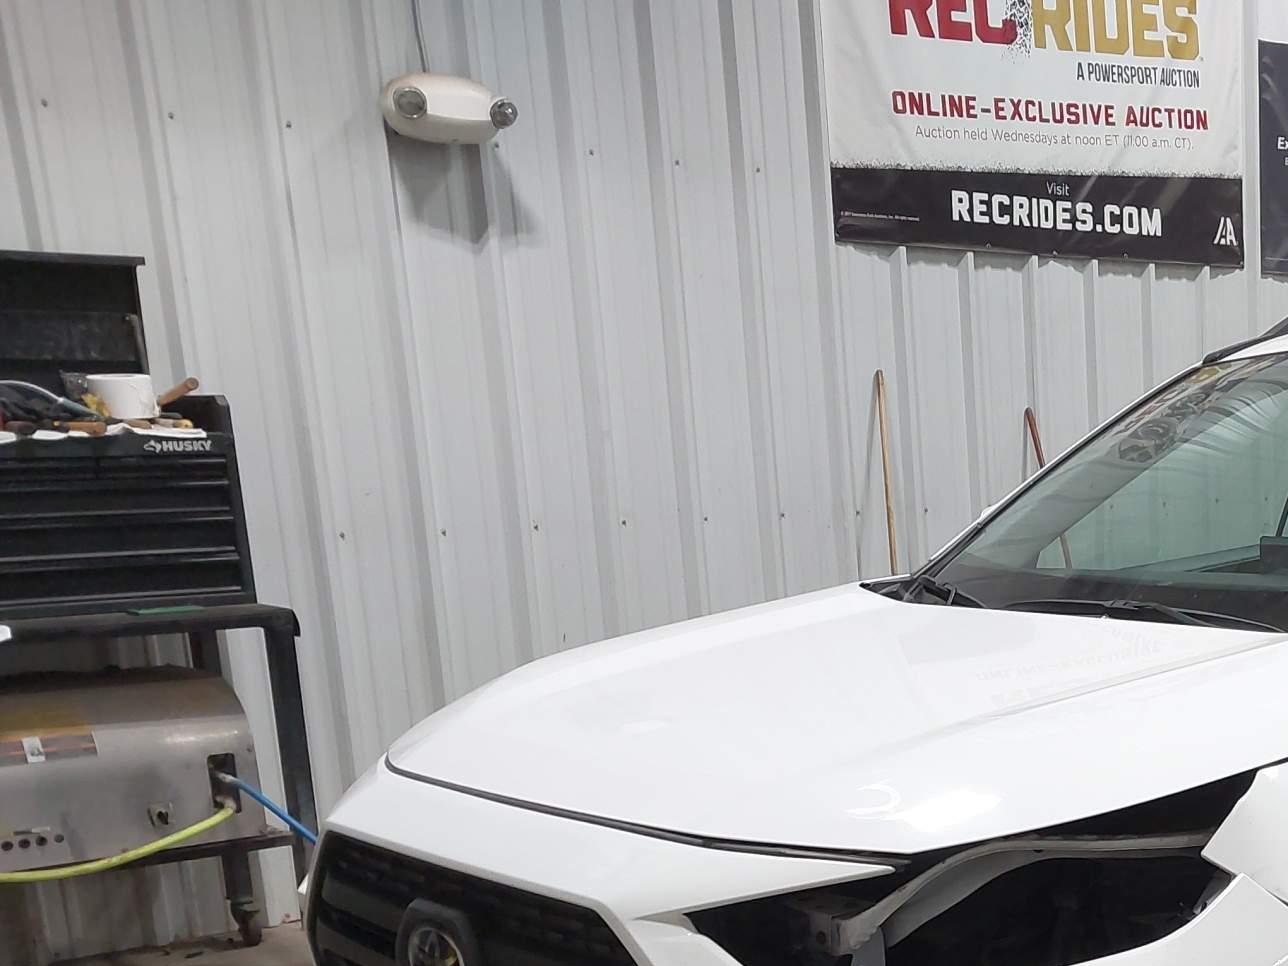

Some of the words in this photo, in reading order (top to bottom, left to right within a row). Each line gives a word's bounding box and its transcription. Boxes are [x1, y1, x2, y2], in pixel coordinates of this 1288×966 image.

[1077, 62, 1085, 81] A
[1087, 62, 1158, 85] POWERSPORT
[1160, 67, 1200, 88] AUCTION
[891, 91, 1116, 127] ONLINE-EXCLUSIVE
[1125, 106, 1209, 130] AUCTION
[915, 125, 960, 139] Auction
[963, 127, 988, 141] held
[991, 128, 1058, 146] Wednesdays
[1060, 132, 1071, 145] at
[1075, 134, 1101, 146] noon
[1105, 134, 1119, 146] ET
[1151, 138, 1172, 149] a.m.
[1046, 181, 1070, 197] Visit
[951, 189, 1162, 237] RECRIDES.COM
[162, 440, 212, 452] HUSKY
